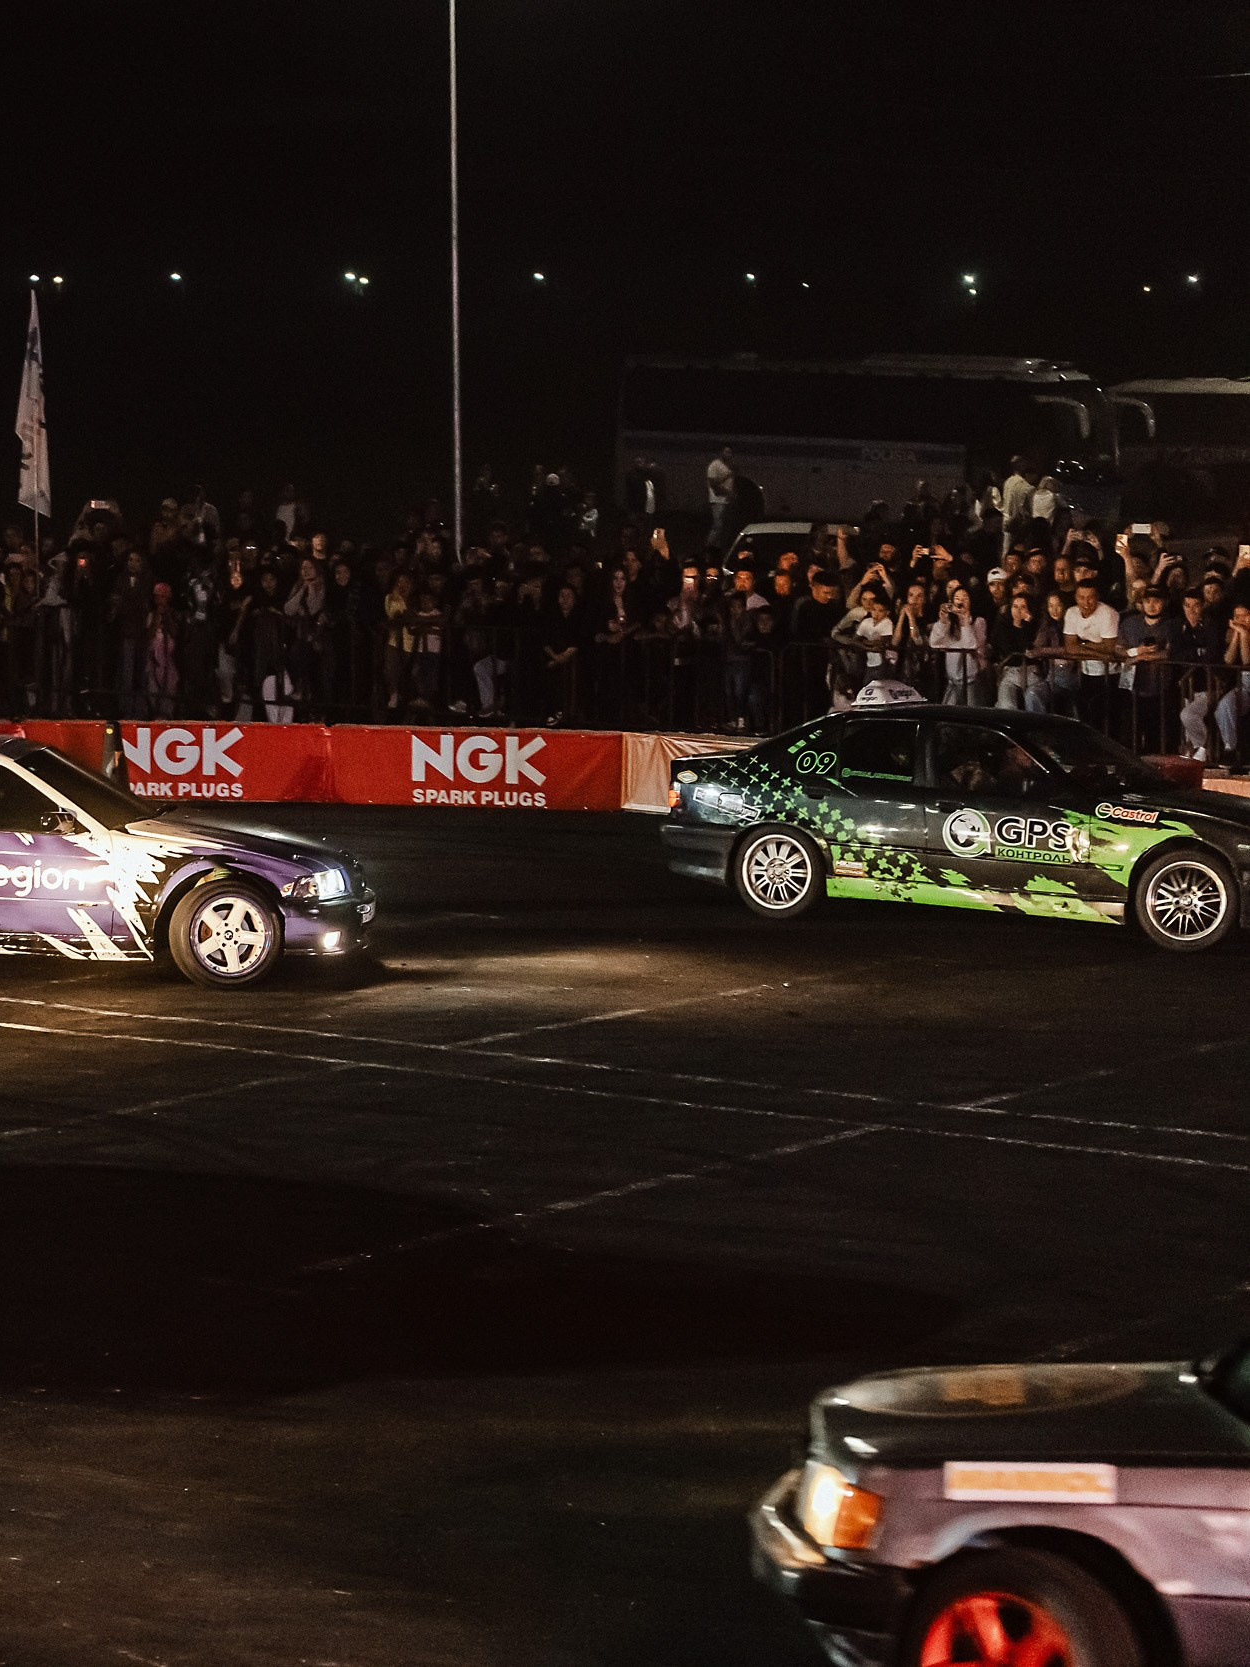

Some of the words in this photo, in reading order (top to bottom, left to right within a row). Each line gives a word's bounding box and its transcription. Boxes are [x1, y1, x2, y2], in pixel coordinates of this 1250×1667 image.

[411, 734, 547, 787] NGK
[796, 750, 837, 774] 09
[129, 782, 174, 797] ARK
[177, 782, 244, 799] PLUGS
[412, 788, 477, 806] SPARK
[480, 790, 547, 807] PLUGS
[1111, 806, 1159, 823] Castrol
[994, 815, 1074, 852] GPS
[996, 847, 1071, 865] КОНТРОЛЬ
